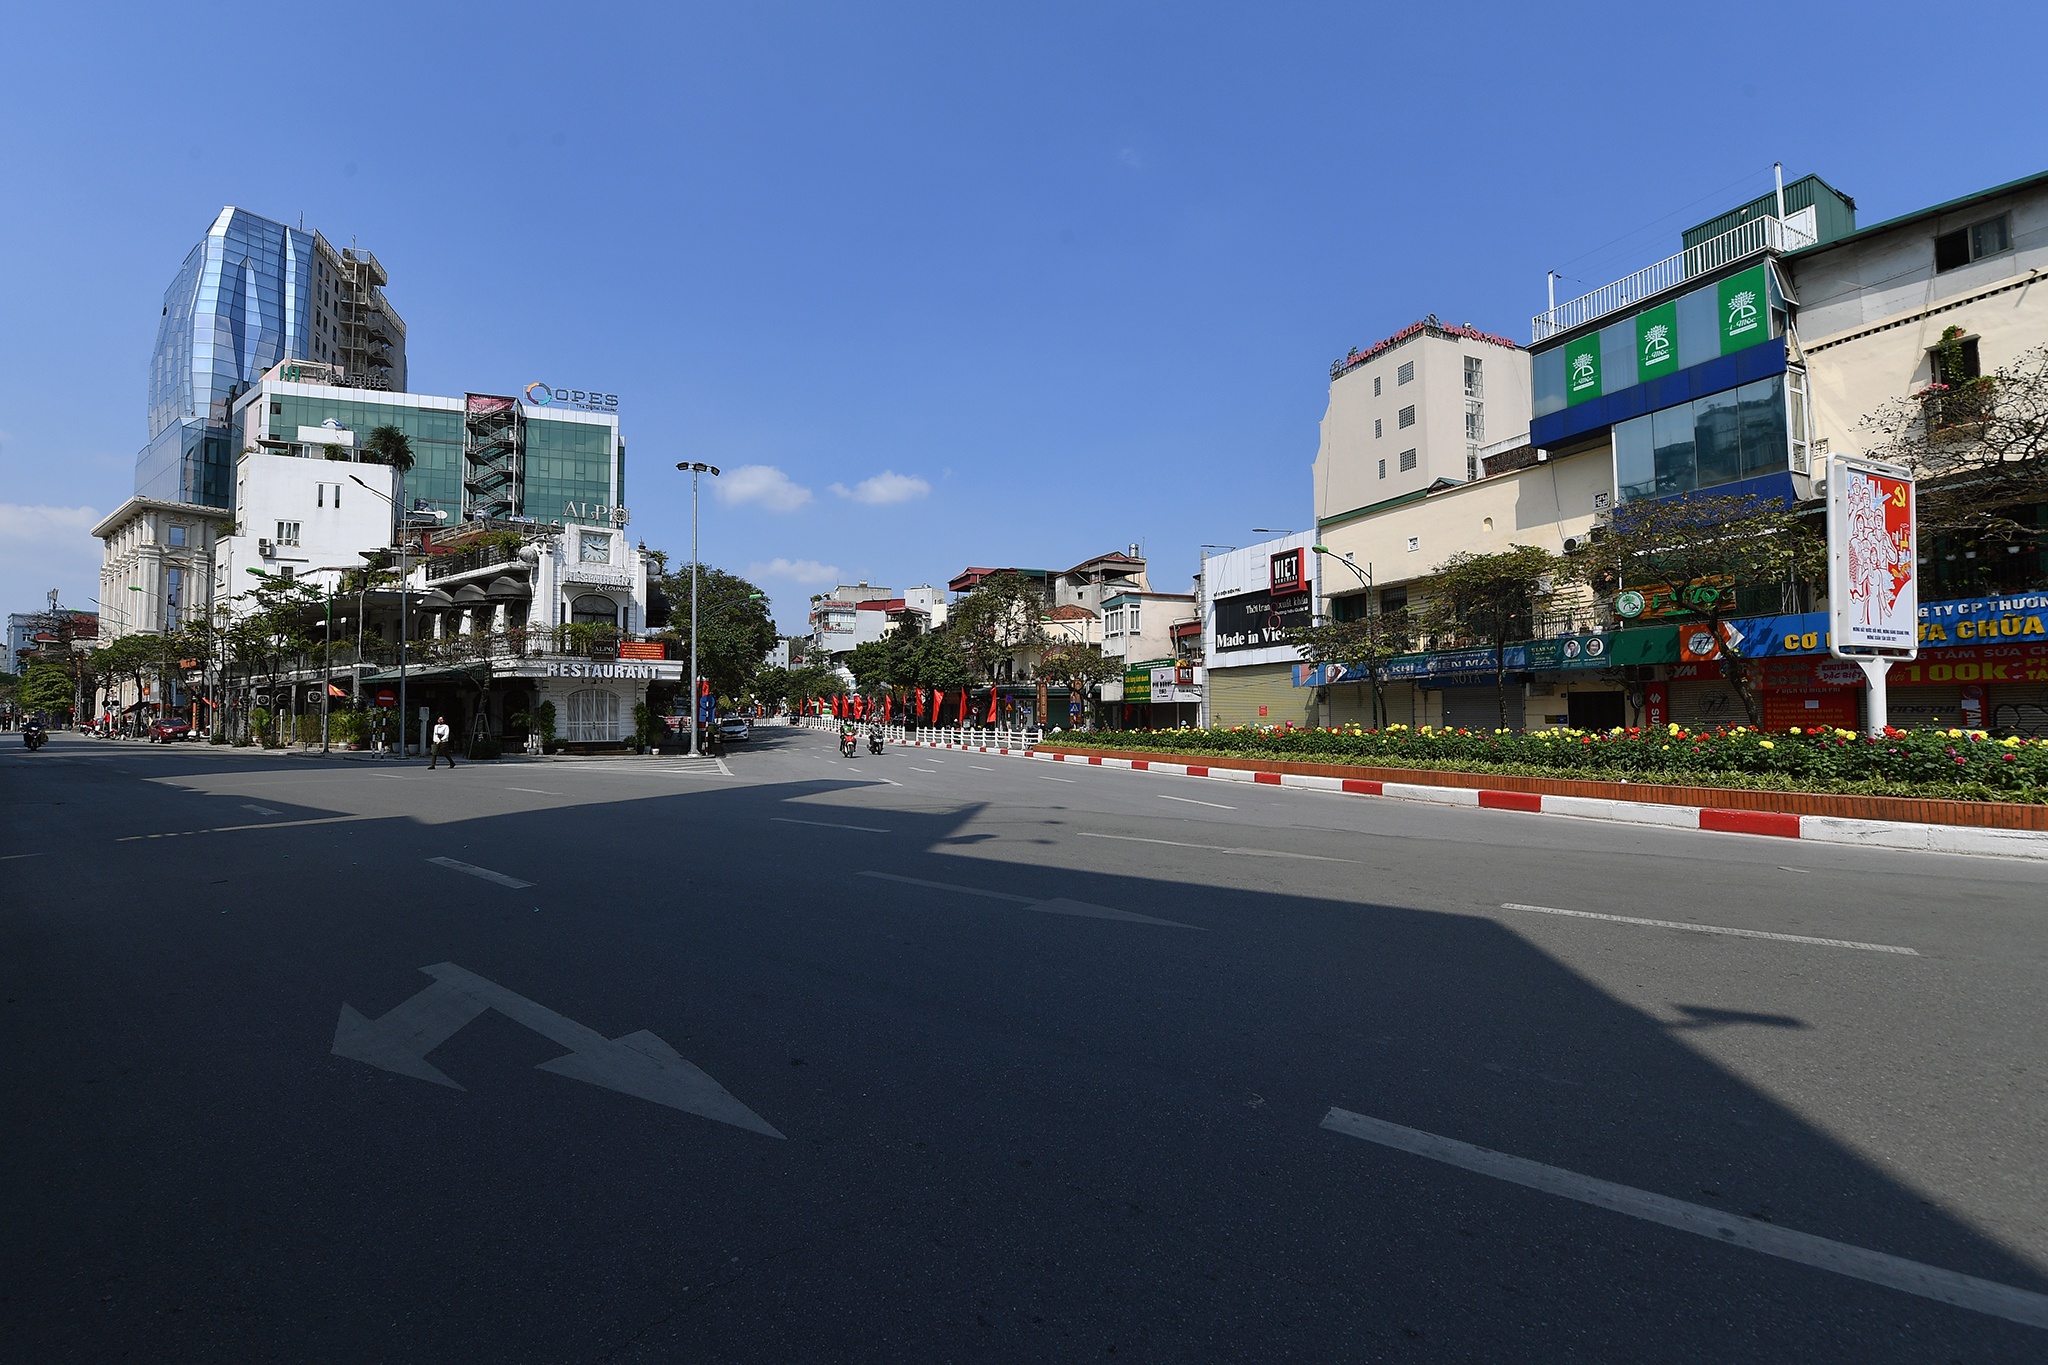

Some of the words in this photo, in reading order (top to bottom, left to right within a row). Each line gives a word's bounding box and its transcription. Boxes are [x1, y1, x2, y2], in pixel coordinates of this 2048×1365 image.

[1373, 338, 1392, 353] SKY
[1393, 320, 1425, 343] HOTEL
[1471, 328, 1489, 342] SKY
[1489, 332, 1516, 349] HOTEL
[555, 388, 619, 407] OPES
[566, 571, 634, 586] RESTAURANT
[604, 584, 634, 592] LOUNGE
[1934, 604, 1954, 617] TY
[1958, 602, 1982, 614] CP
[1956, 613, 2045, 640] CHỮA
[1216, 631, 1245, 648] Made
[1247, 630, 1259, 645] in
[1784, 632, 1818, 650] CƠ
[547, 663, 660, 679] RESTAURANT
